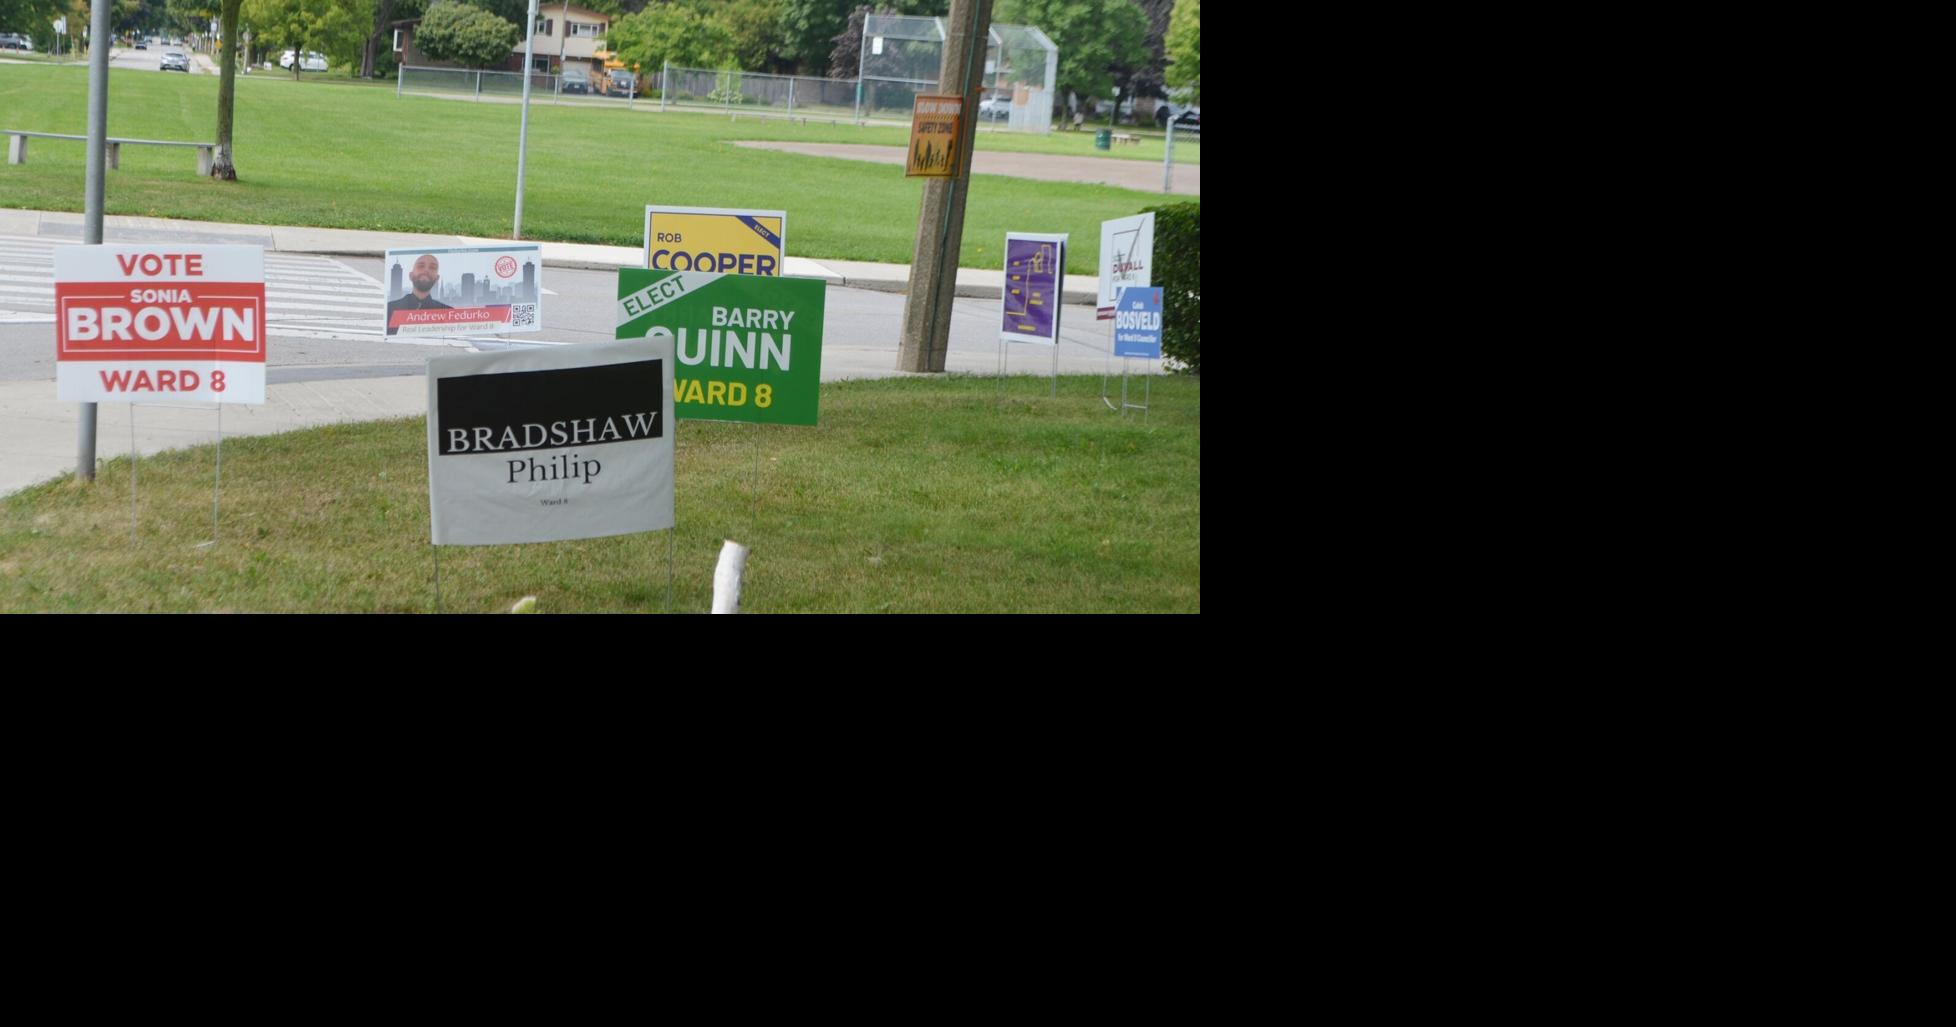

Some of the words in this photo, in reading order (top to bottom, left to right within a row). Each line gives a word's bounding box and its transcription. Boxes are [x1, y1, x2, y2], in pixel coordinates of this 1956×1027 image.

[657, 233, 682, 243] ROB
[754, 224, 770, 238] ELECT
[116, 254, 203, 276] VOTE
[652, 249, 776, 277] COOPER
[130, 289, 192, 304] SONIA
[622, 275, 685, 317] ELECT
[67, 307, 254, 342] BROWN
[406, 312, 445, 323] Andrew
[448, 309, 490, 321] Fedurko
[712, 306, 795, 331] BARRY
[1116, 311, 1160, 331] BOSVELD
[644, 325, 792, 371] UINN
[99, 370, 200, 392] WARD
[210, 370, 226, 393] 8
[755, 383, 773, 408] 8
[448, 411, 658, 453] BRADSHAW
[507, 454, 601, 484] Philip
